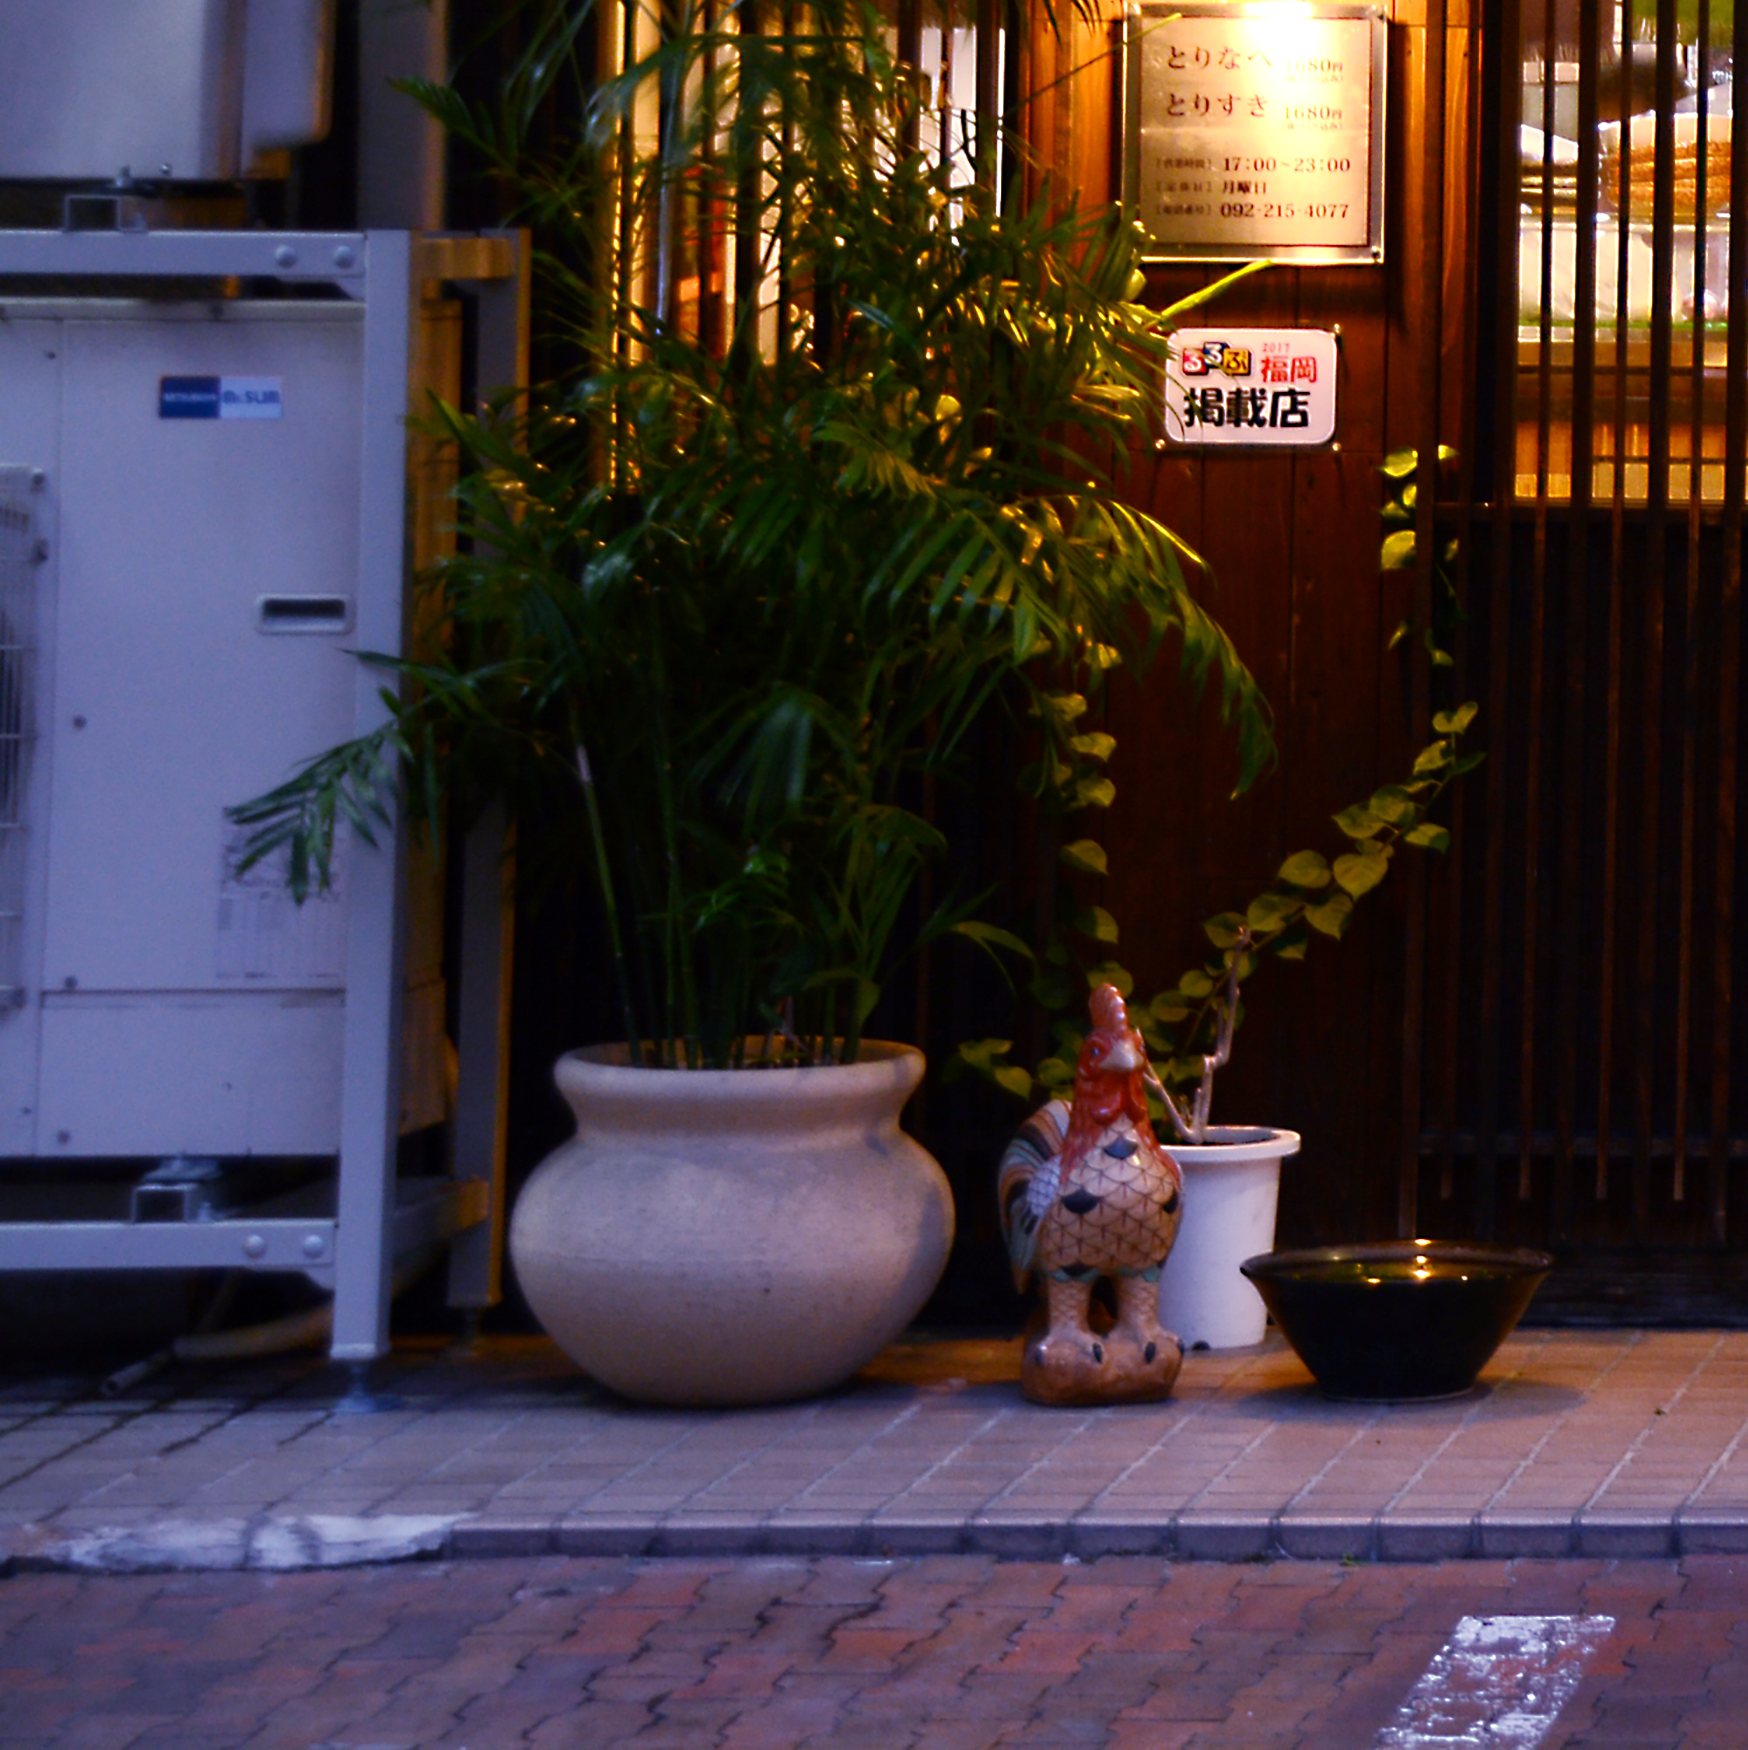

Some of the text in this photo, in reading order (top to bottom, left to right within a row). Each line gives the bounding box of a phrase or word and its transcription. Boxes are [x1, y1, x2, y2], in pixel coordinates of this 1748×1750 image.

[1167, 93, 1268, 118] とりすき
[1261, 355, 1317, 383] 福岡
[1184, 387, 1311, 428] 掲載店
